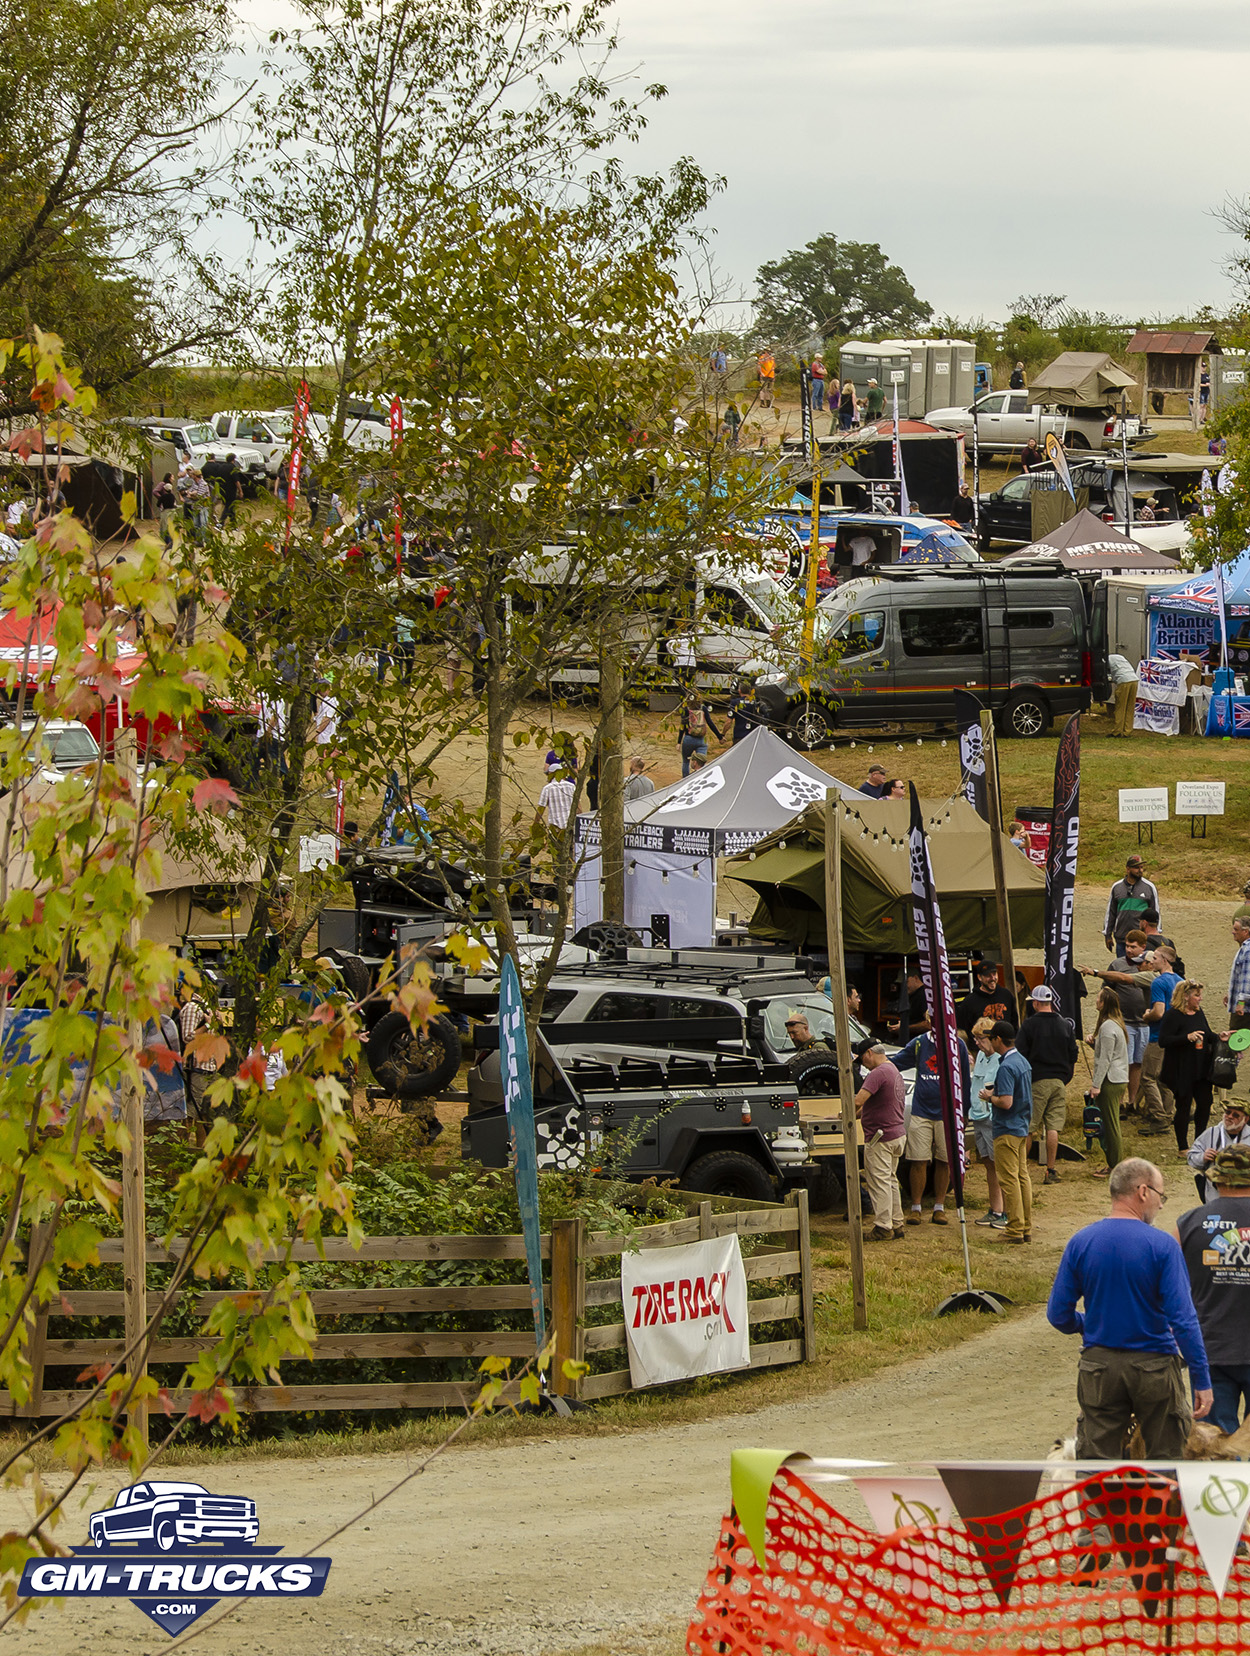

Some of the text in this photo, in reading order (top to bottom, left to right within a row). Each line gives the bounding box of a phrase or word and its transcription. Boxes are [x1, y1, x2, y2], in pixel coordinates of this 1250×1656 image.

[1066, 541, 1141, 553] METHOD
[1157, 612, 1214, 629] Atlantic
[1157, 629, 1206, 645] British
[1121, 803, 1167, 812] EXHIBITORS
[624, 834, 664, 850] TRAILERS
[1202, 1220, 1238, 1230] SAFETY
[632, 1281, 677, 1328] TIRE
